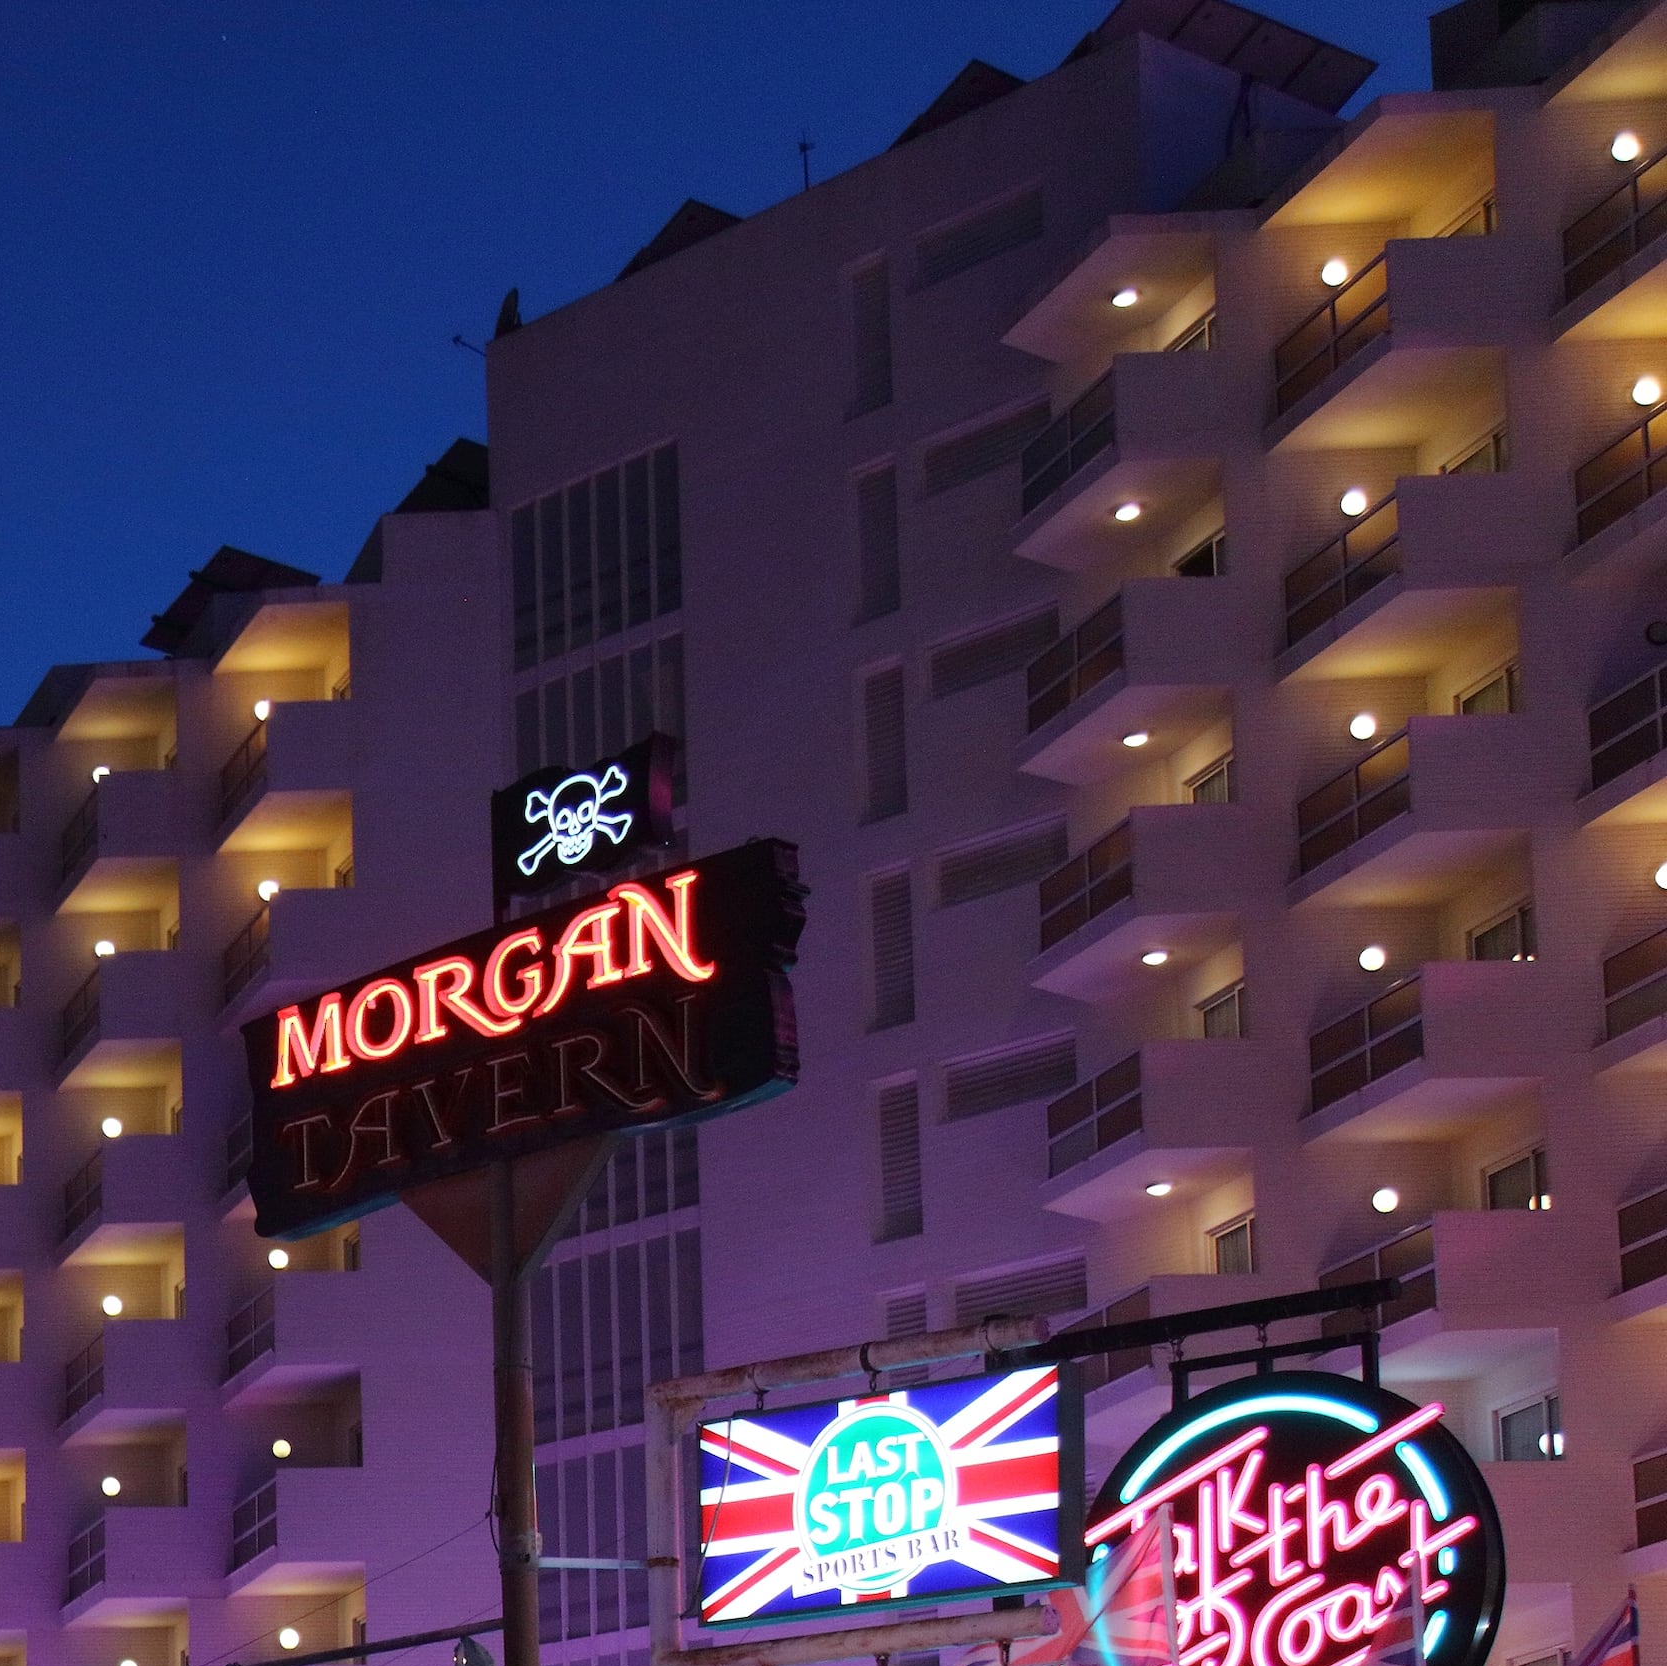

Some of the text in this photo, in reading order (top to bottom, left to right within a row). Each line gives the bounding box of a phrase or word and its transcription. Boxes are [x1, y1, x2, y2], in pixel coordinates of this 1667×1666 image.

[270, 870, 717, 1089] MORGAN
[282, 993, 725, 1193] TAVERN
[826, 1431, 928, 1485] LAST
[808, 1477, 945, 1546] STOP
[801, 1527, 961, 1588] SPORTS BAR
